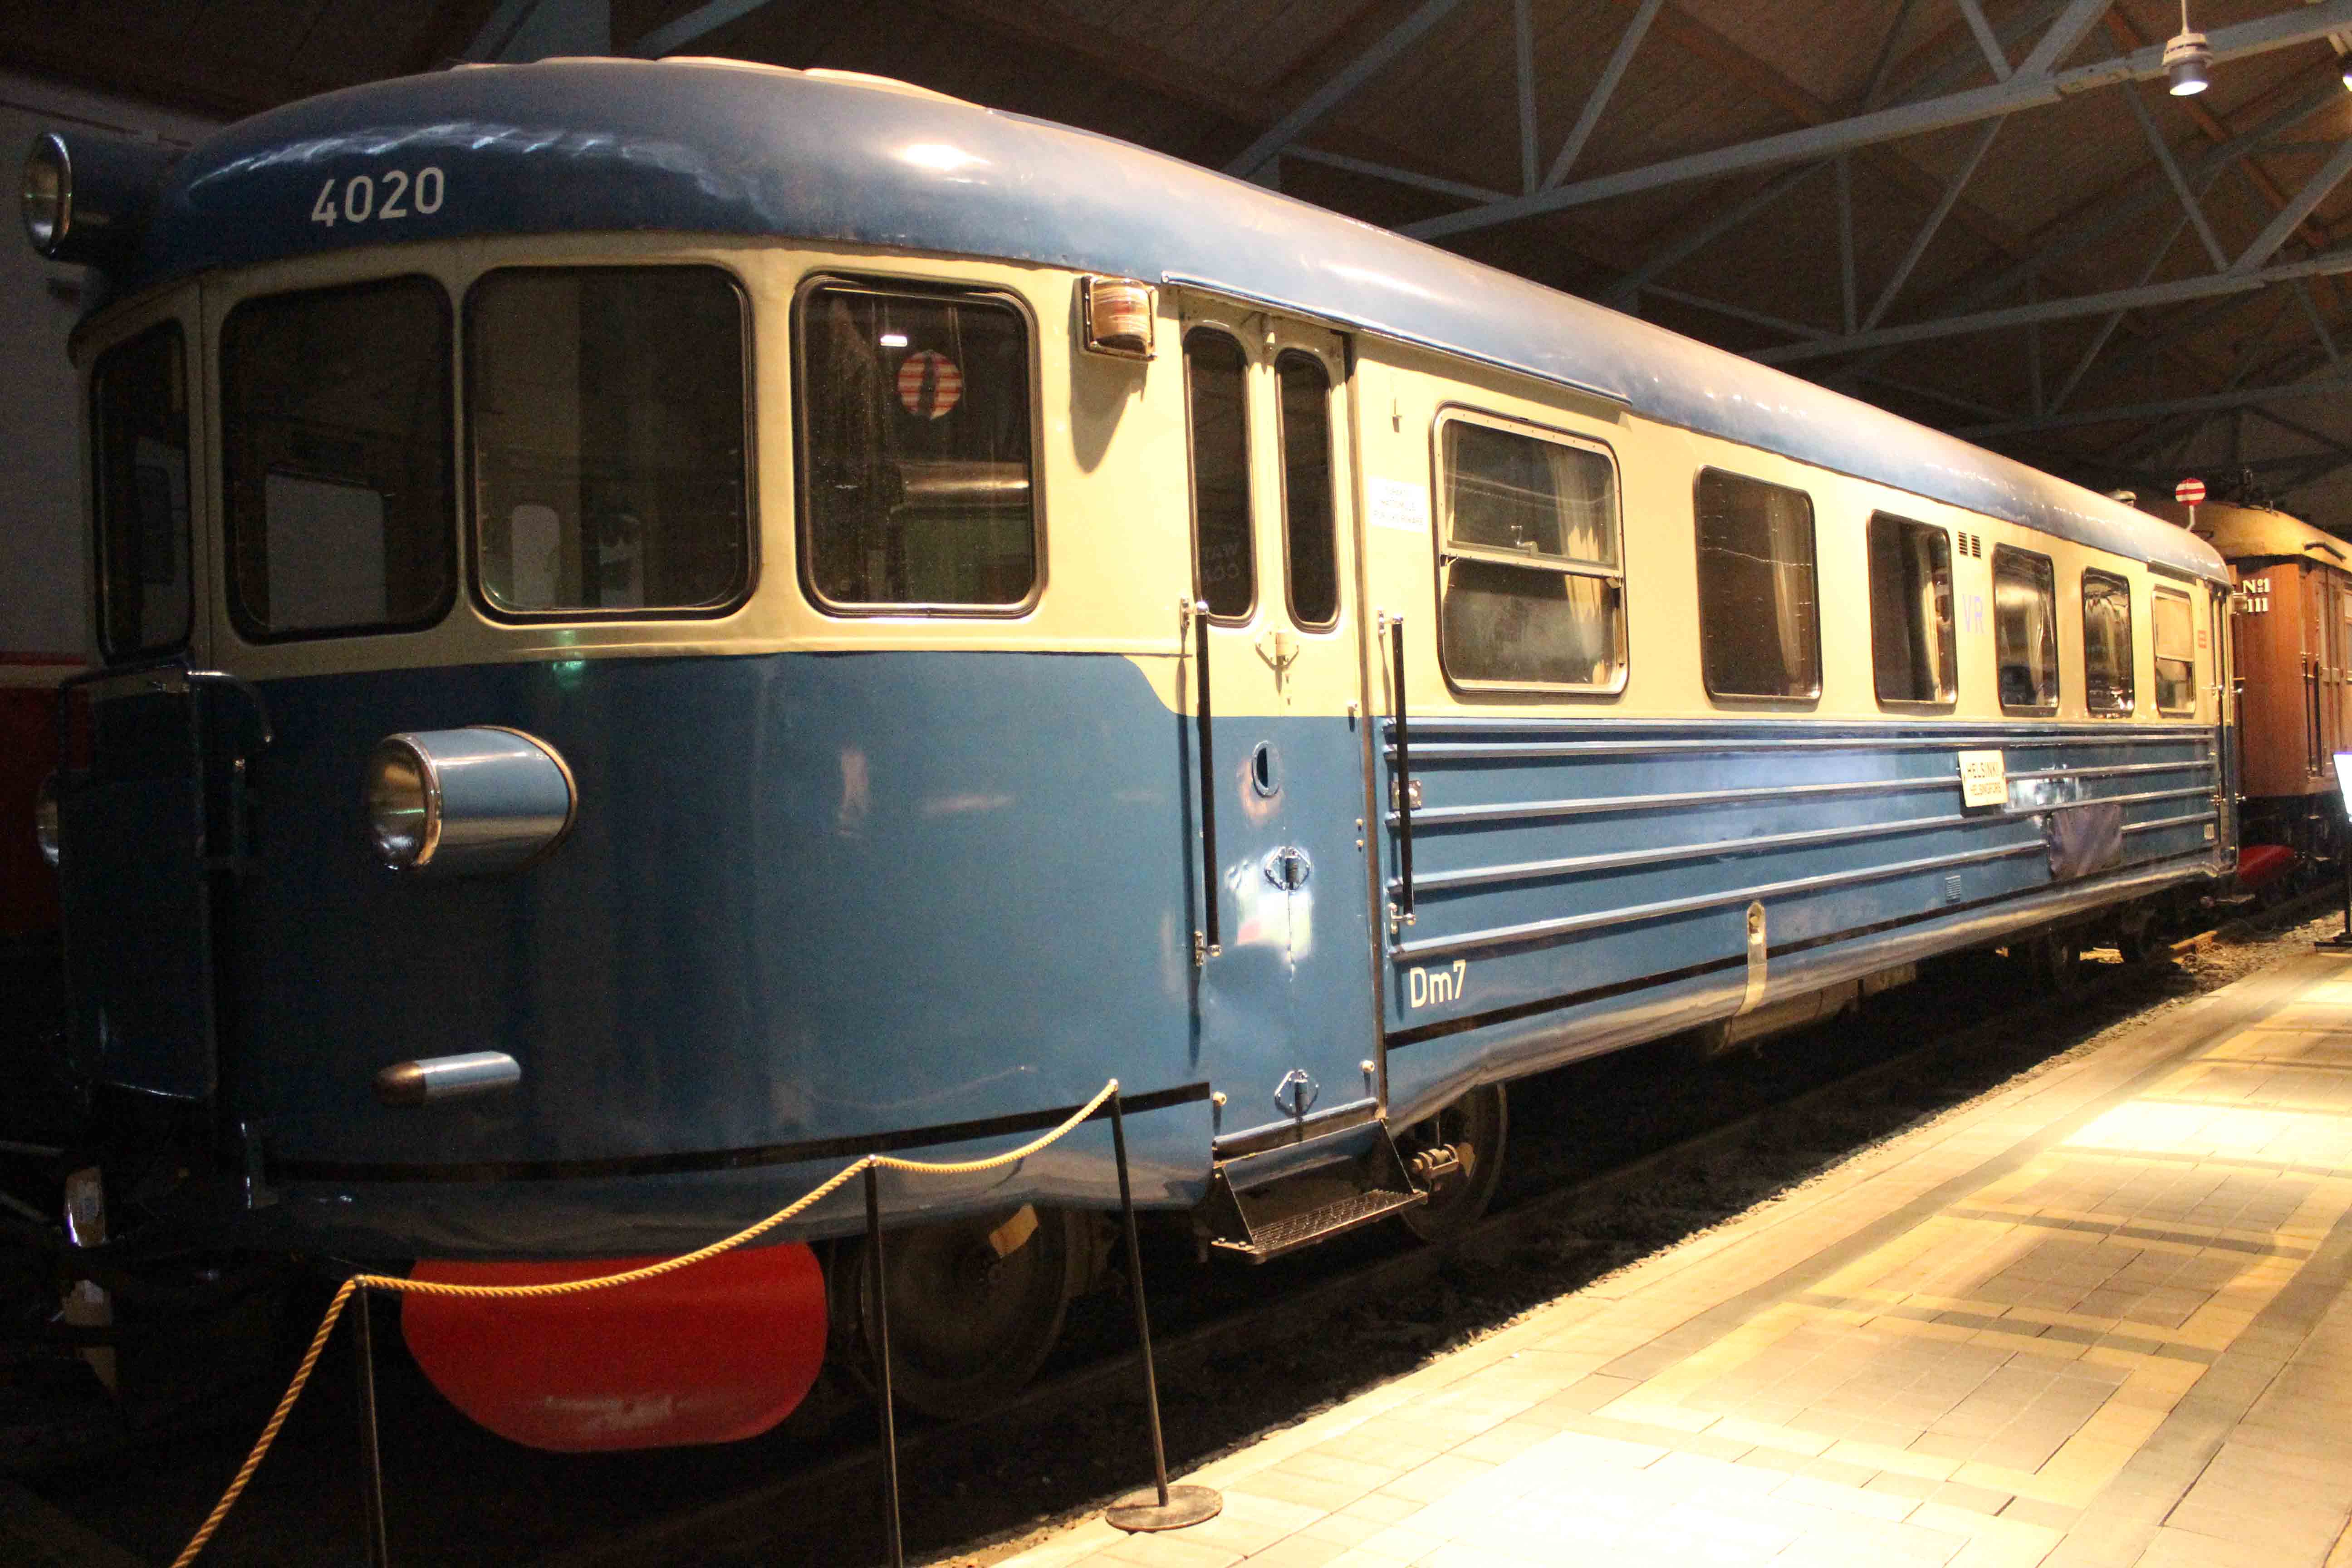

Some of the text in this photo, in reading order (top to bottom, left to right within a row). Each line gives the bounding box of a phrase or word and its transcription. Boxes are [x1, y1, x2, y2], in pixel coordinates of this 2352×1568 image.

[311, 167, 445, 227] 4020
[1962, 593, 1984, 633] VR
[1966, 762, 2000, 778] HELSINKI
[1410, 959, 1466, 1008] Dm7
